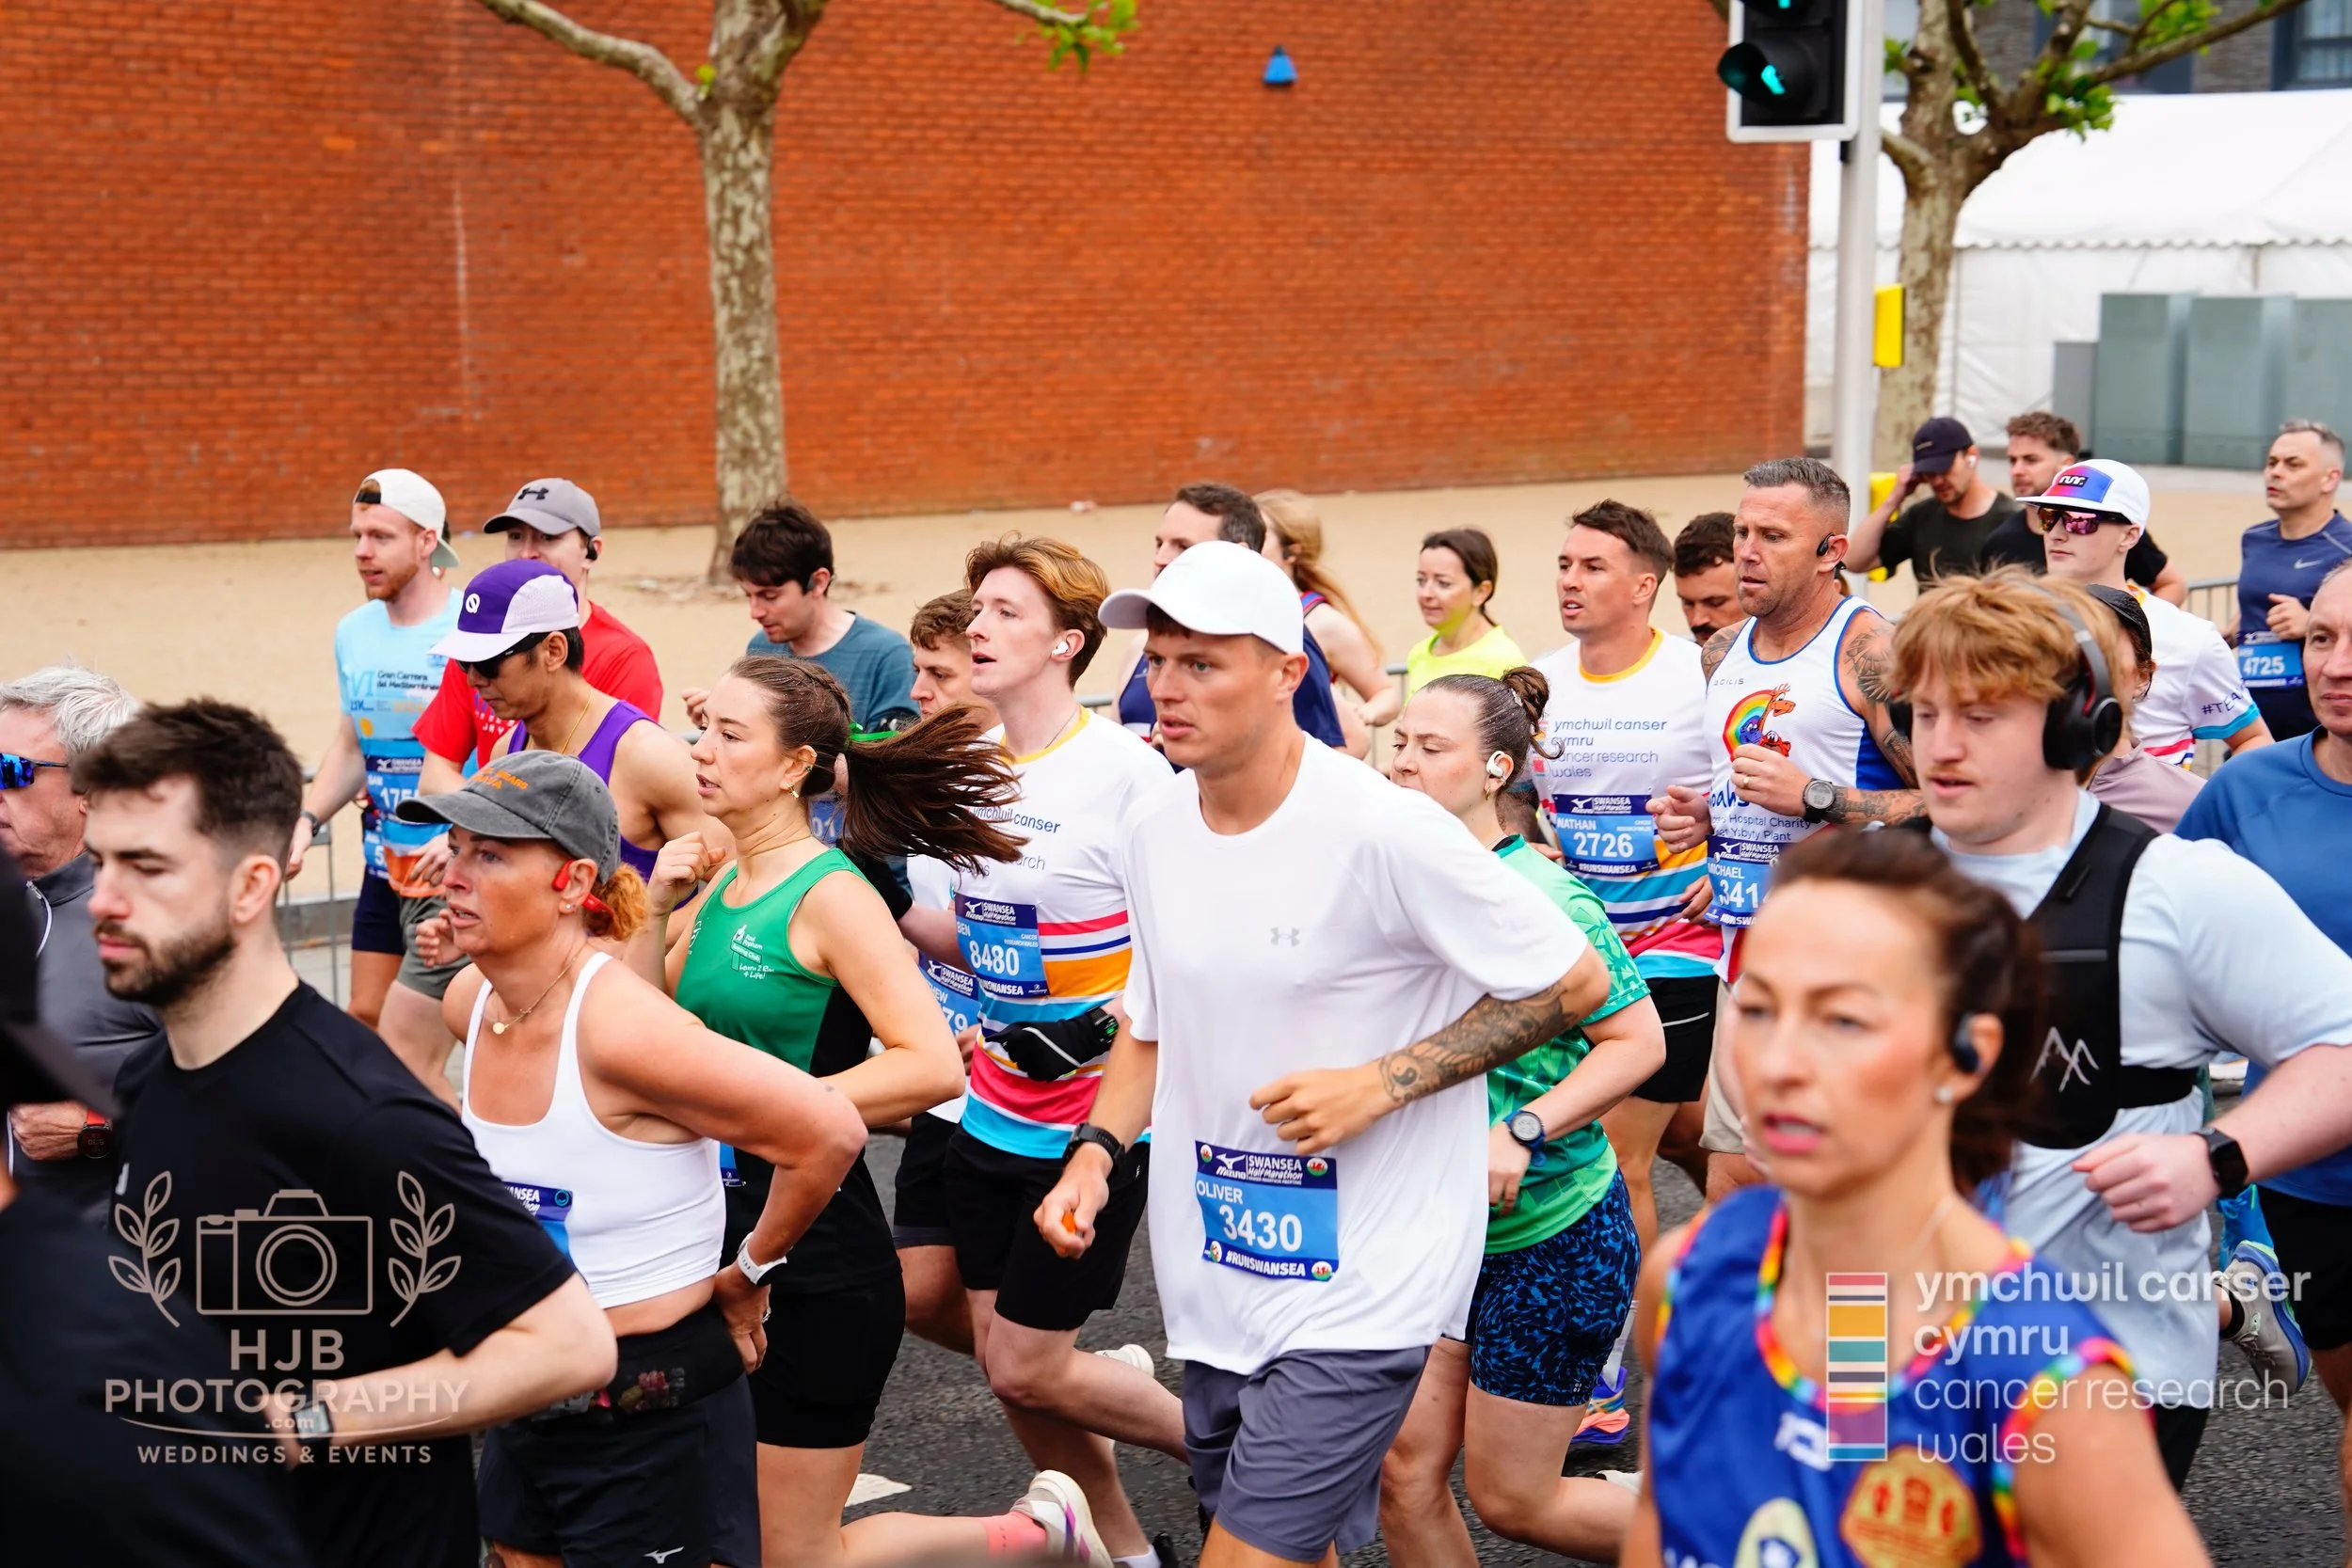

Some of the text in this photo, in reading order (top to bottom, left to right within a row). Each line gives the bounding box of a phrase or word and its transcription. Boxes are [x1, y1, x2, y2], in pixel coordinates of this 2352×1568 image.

[2242, 656, 2285, 676] 4725
[1554, 718, 1667, 733] ymchwil canser
[1550, 736, 1594, 747] cymru
[1597, 751, 1659, 764] research
[1552, 766, 1592, 778] wales
[1594, 797, 1631, 806] SWANSEA
[1014, 813, 1061, 834] canser
[1557, 816, 1597, 831] NATHAN
[1729, 814, 1767, 828] Hospital
[1769, 816, 1812, 830] Charity
[1764, 831, 1792, 842] Plant
[1573, 831, 1635, 859] 2726
[1740, 842, 1780, 854] SWANSEA
[1708, 862, 1745, 879] MICHAEL
[983, 902, 1016, 916] SWANSEA
[956, 921, 972, 937] BEN
[969, 940, 1020, 976] 8480
[942, 967, 974, 988] SWANSEA
[1248, 1154, 1302, 1172] SWANSEA
[1248, 1167, 1304, 1180] Half Marathon
[1196, 1180, 1244, 1205] OLIVER
[1218, 1204, 1303, 1253] 3430
[1225, 1250, 1307, 1277] #RUNSWANSEA
